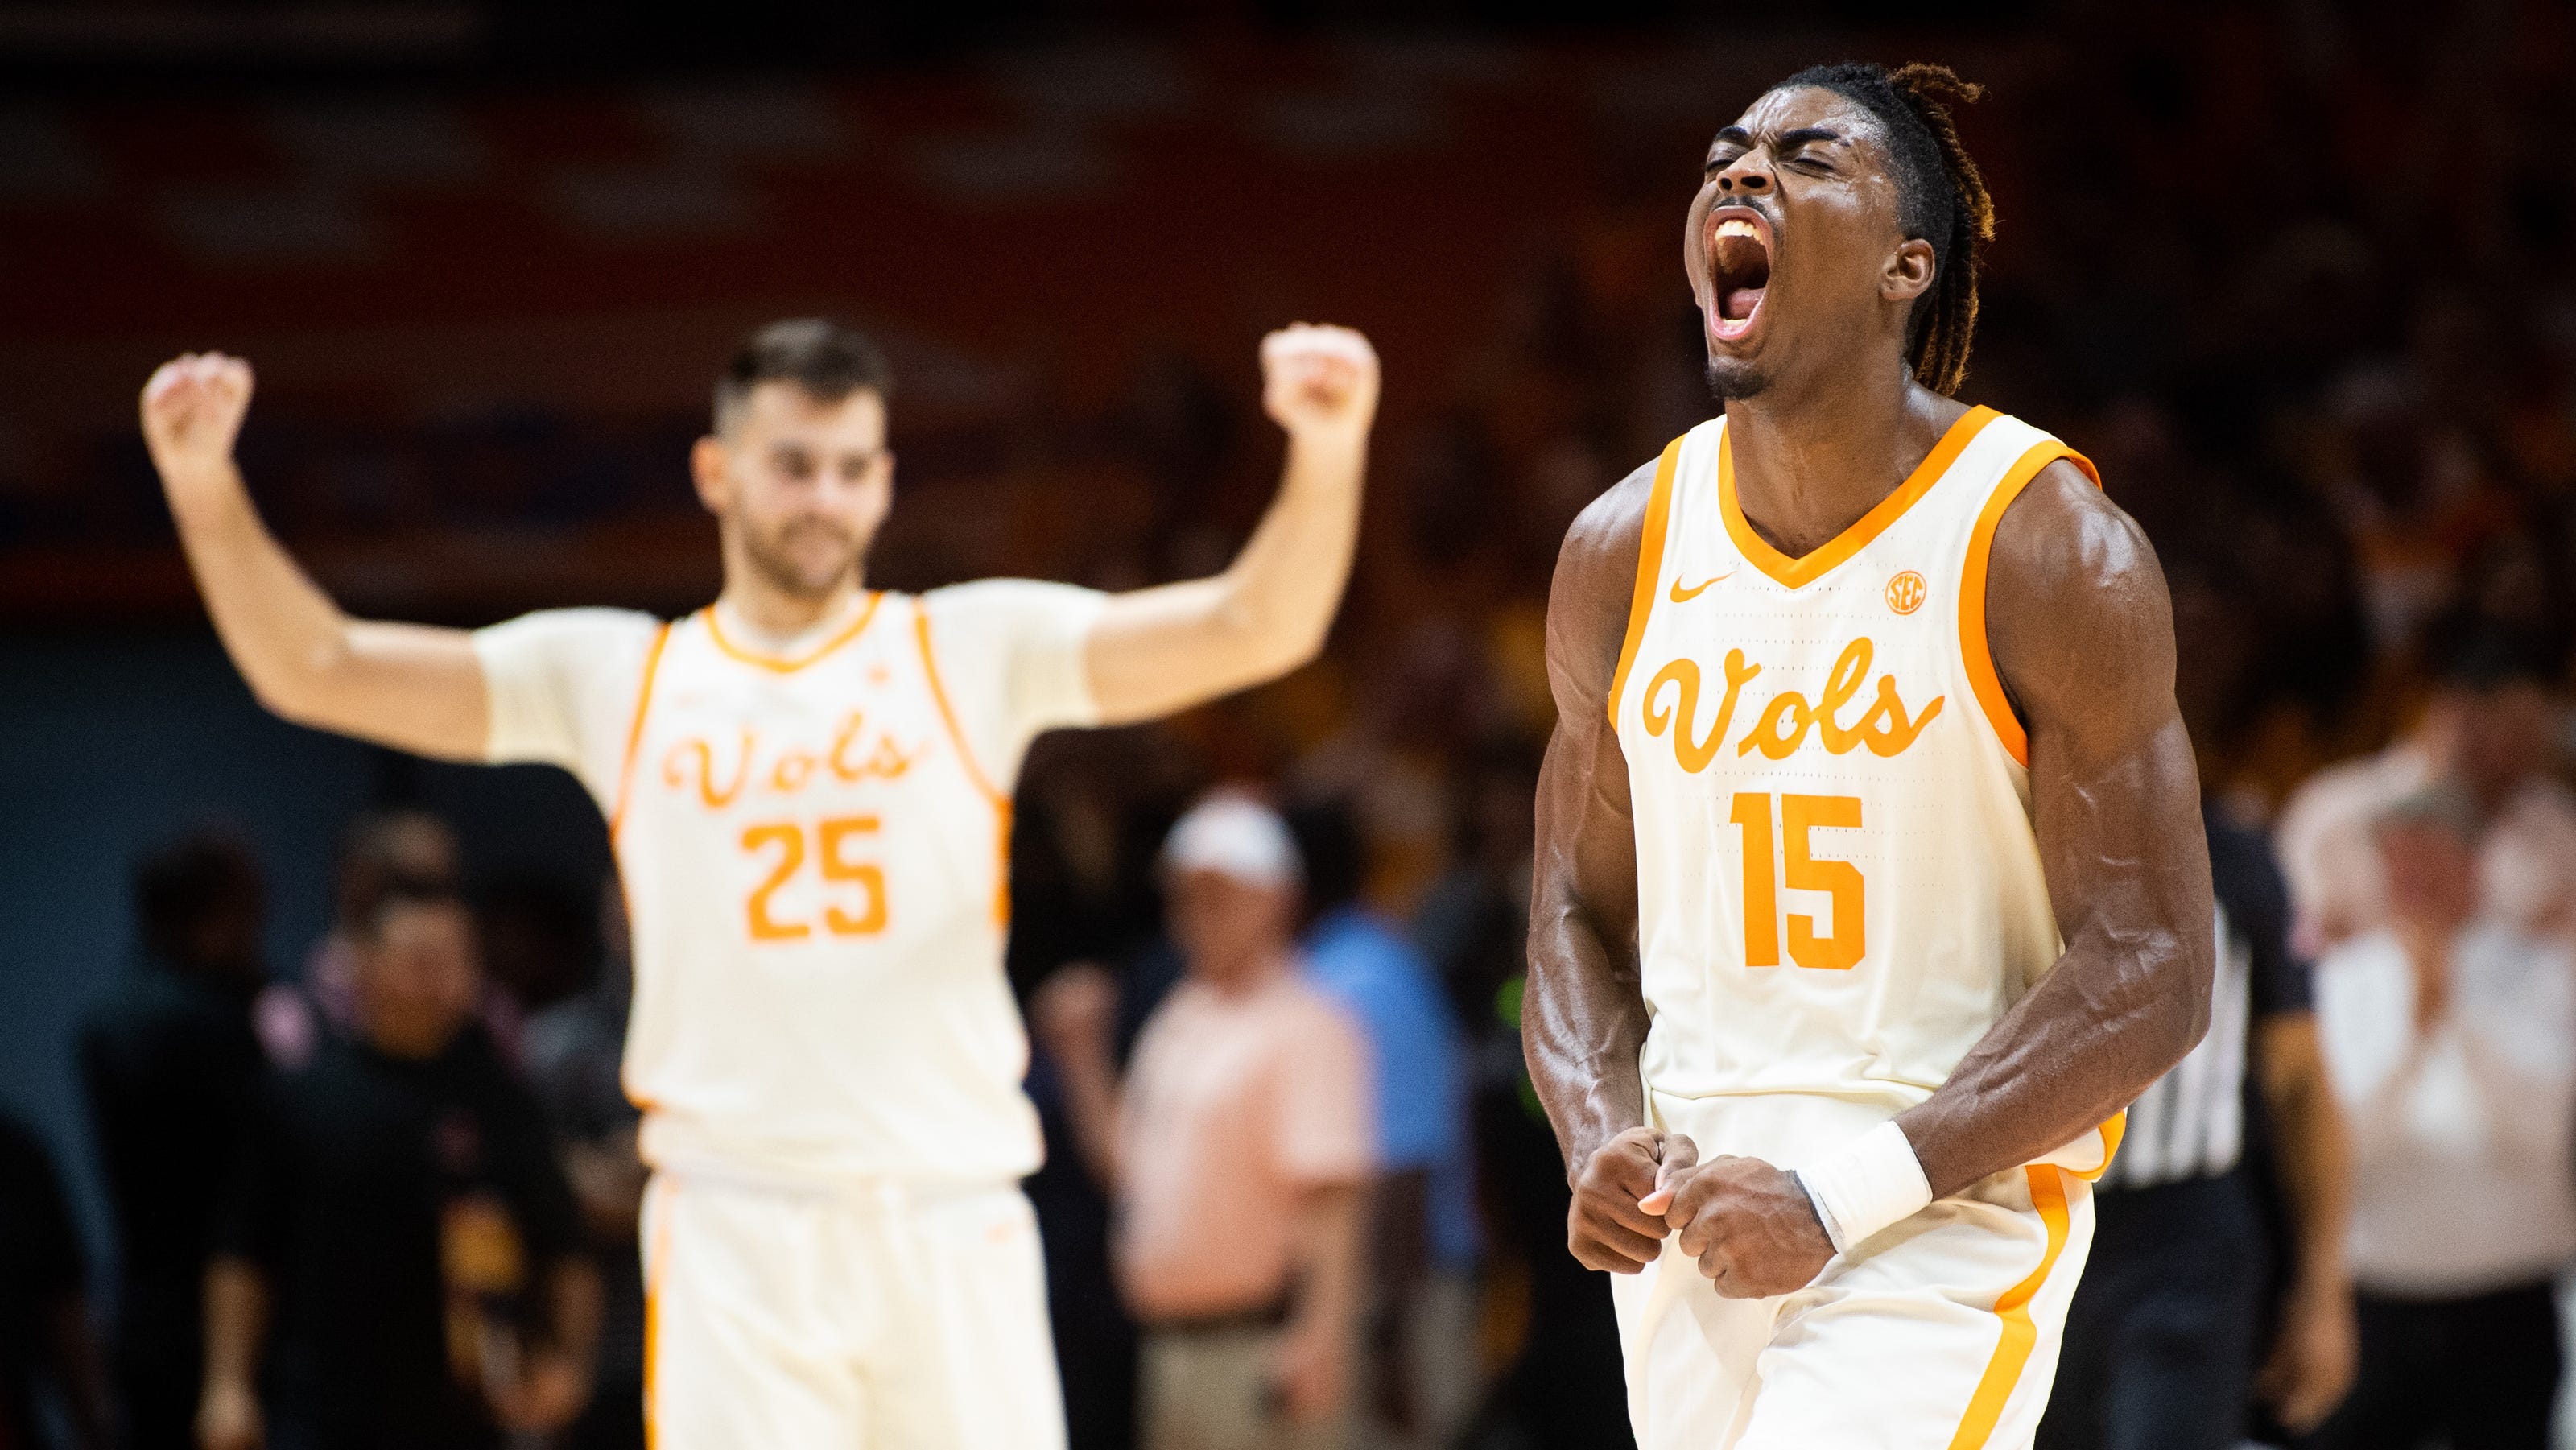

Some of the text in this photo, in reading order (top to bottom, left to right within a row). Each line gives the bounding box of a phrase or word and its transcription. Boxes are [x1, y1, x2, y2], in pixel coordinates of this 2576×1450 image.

[1889, 574, 1924, 611] SEC
[662, 709, 932, 809] Vols
[1643, 637, 1946, 774] Vols
[741, 816, 888, 941] 25
[1730, 792, 1866, 970] 15
